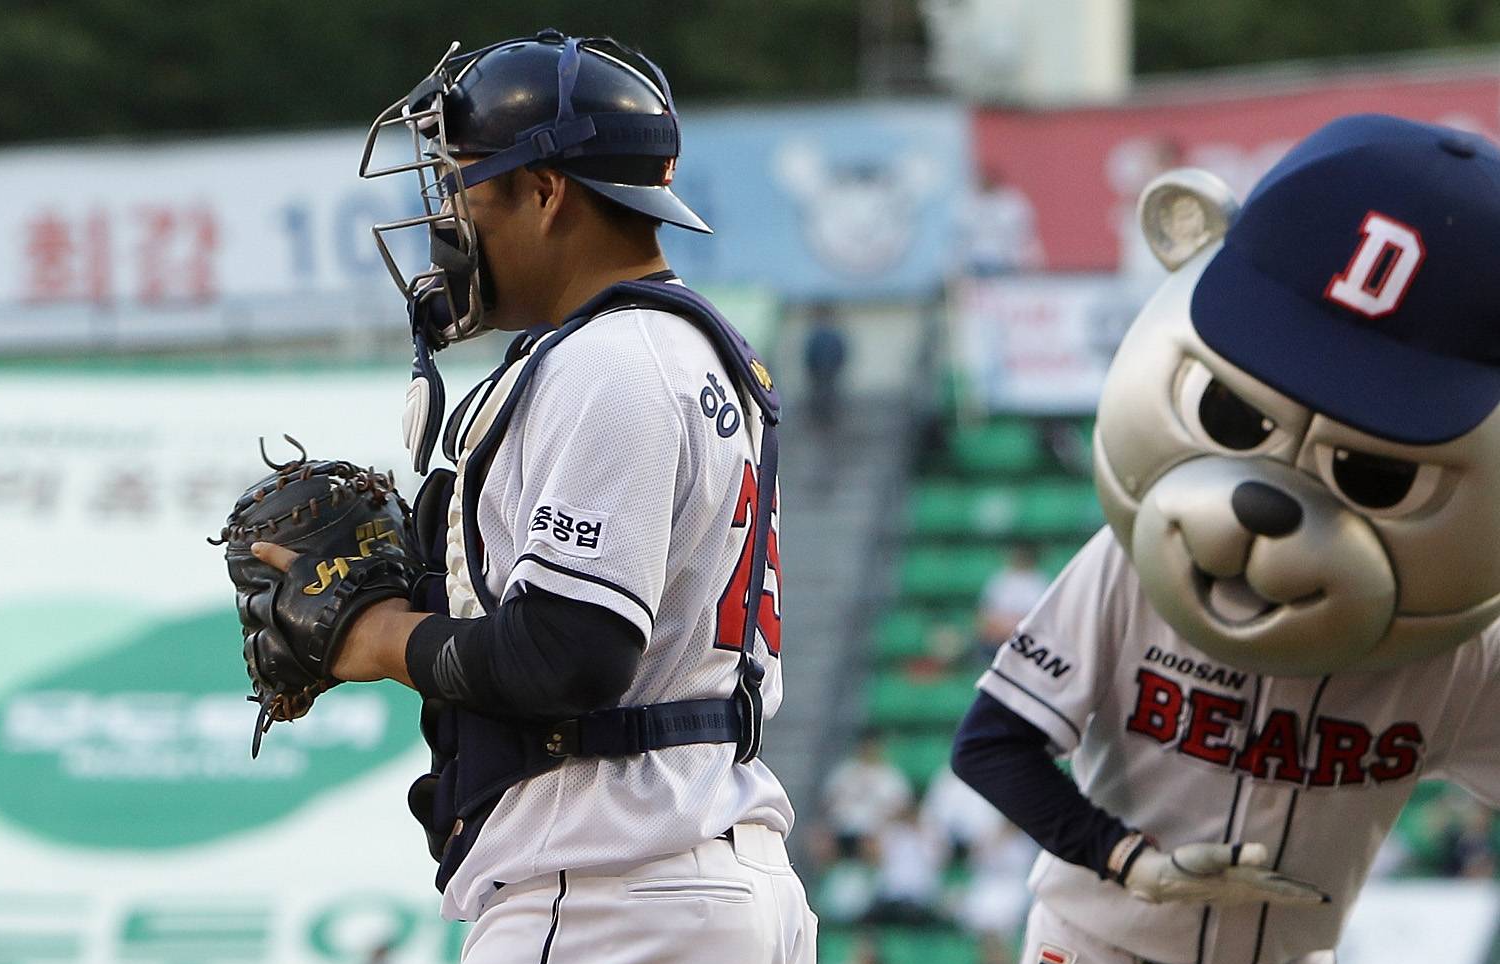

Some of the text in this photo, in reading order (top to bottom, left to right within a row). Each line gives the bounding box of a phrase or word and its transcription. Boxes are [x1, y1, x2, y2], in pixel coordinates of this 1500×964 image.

[1324, 209, 1428, 320] D
[1144, 645, 1248, 691] DOOSAN
[1126, 667, 1426, 788] BEARS
